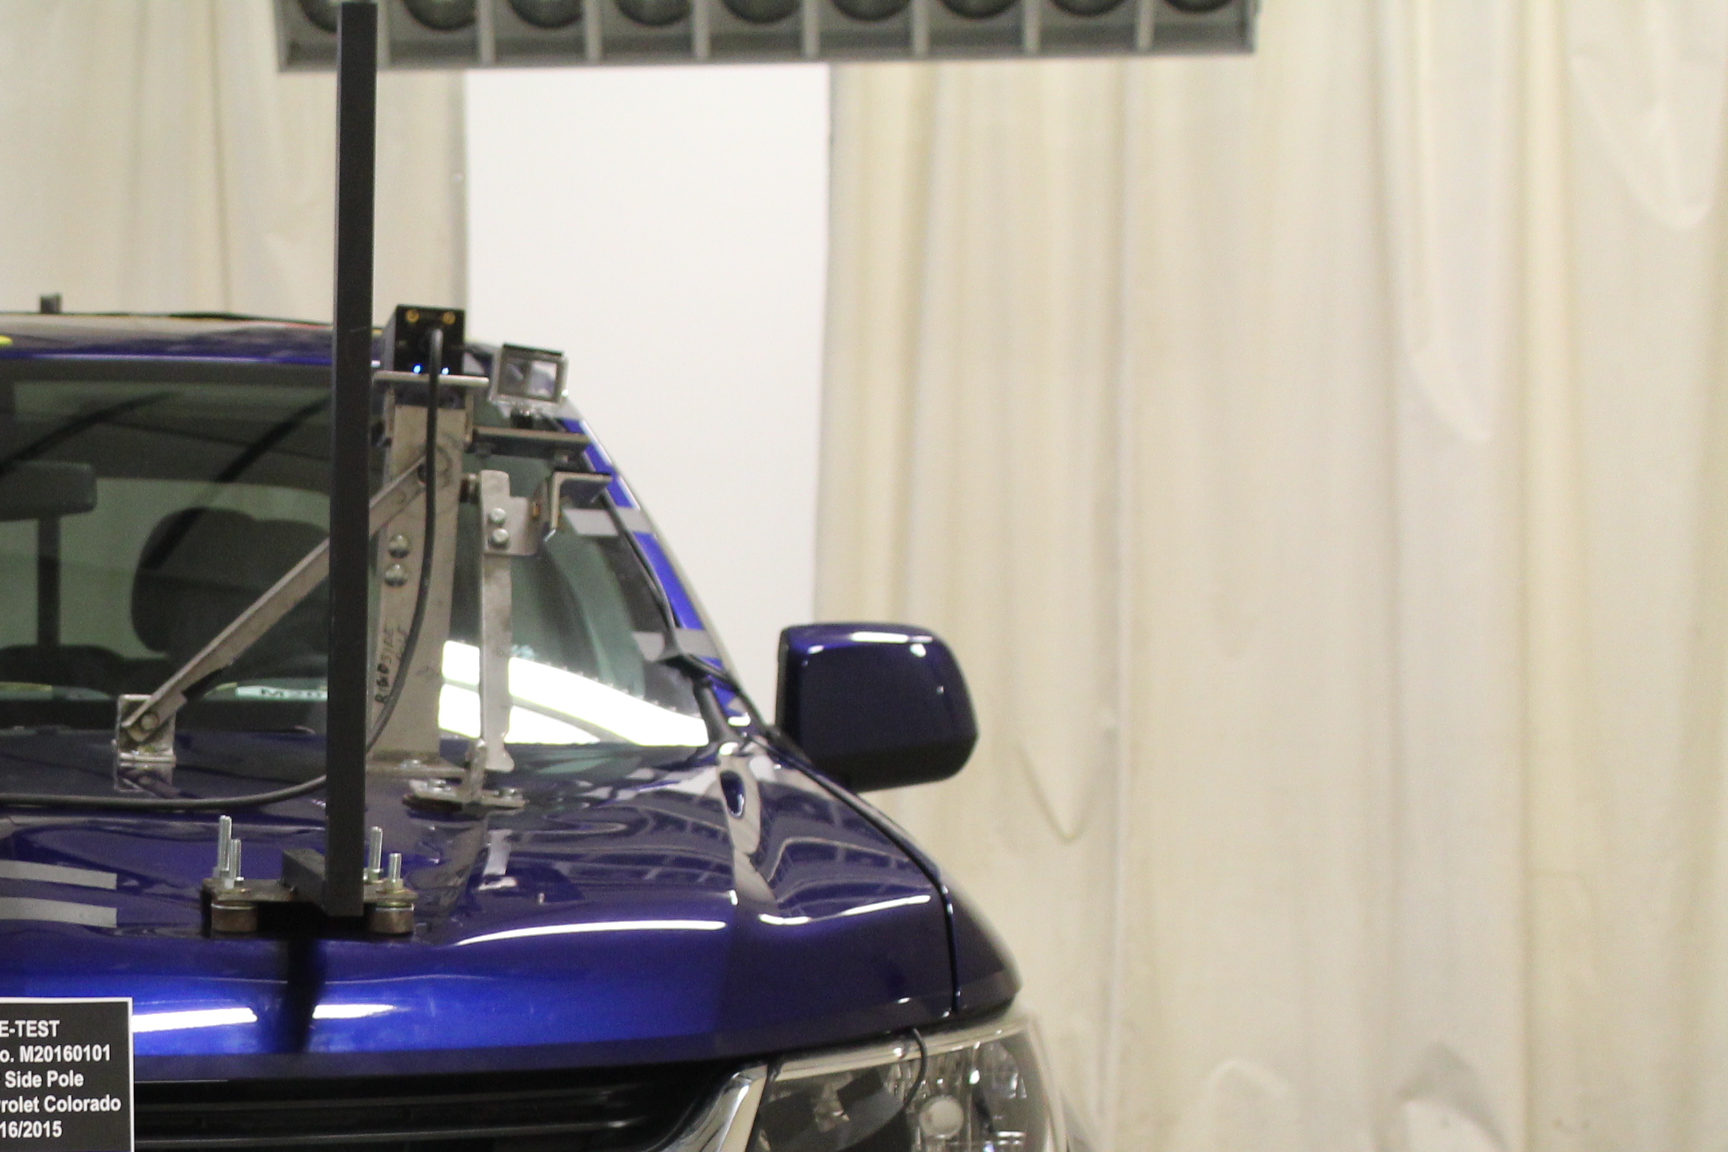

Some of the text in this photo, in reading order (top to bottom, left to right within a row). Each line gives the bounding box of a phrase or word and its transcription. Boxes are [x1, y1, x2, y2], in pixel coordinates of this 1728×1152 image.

[19, 1043, 110, 1063] M20160101
[4, 1070, 43, 1089] Side
[46, 1069, 85, 1088] Pole
[43, 1093, 122, 1113] Colorado
